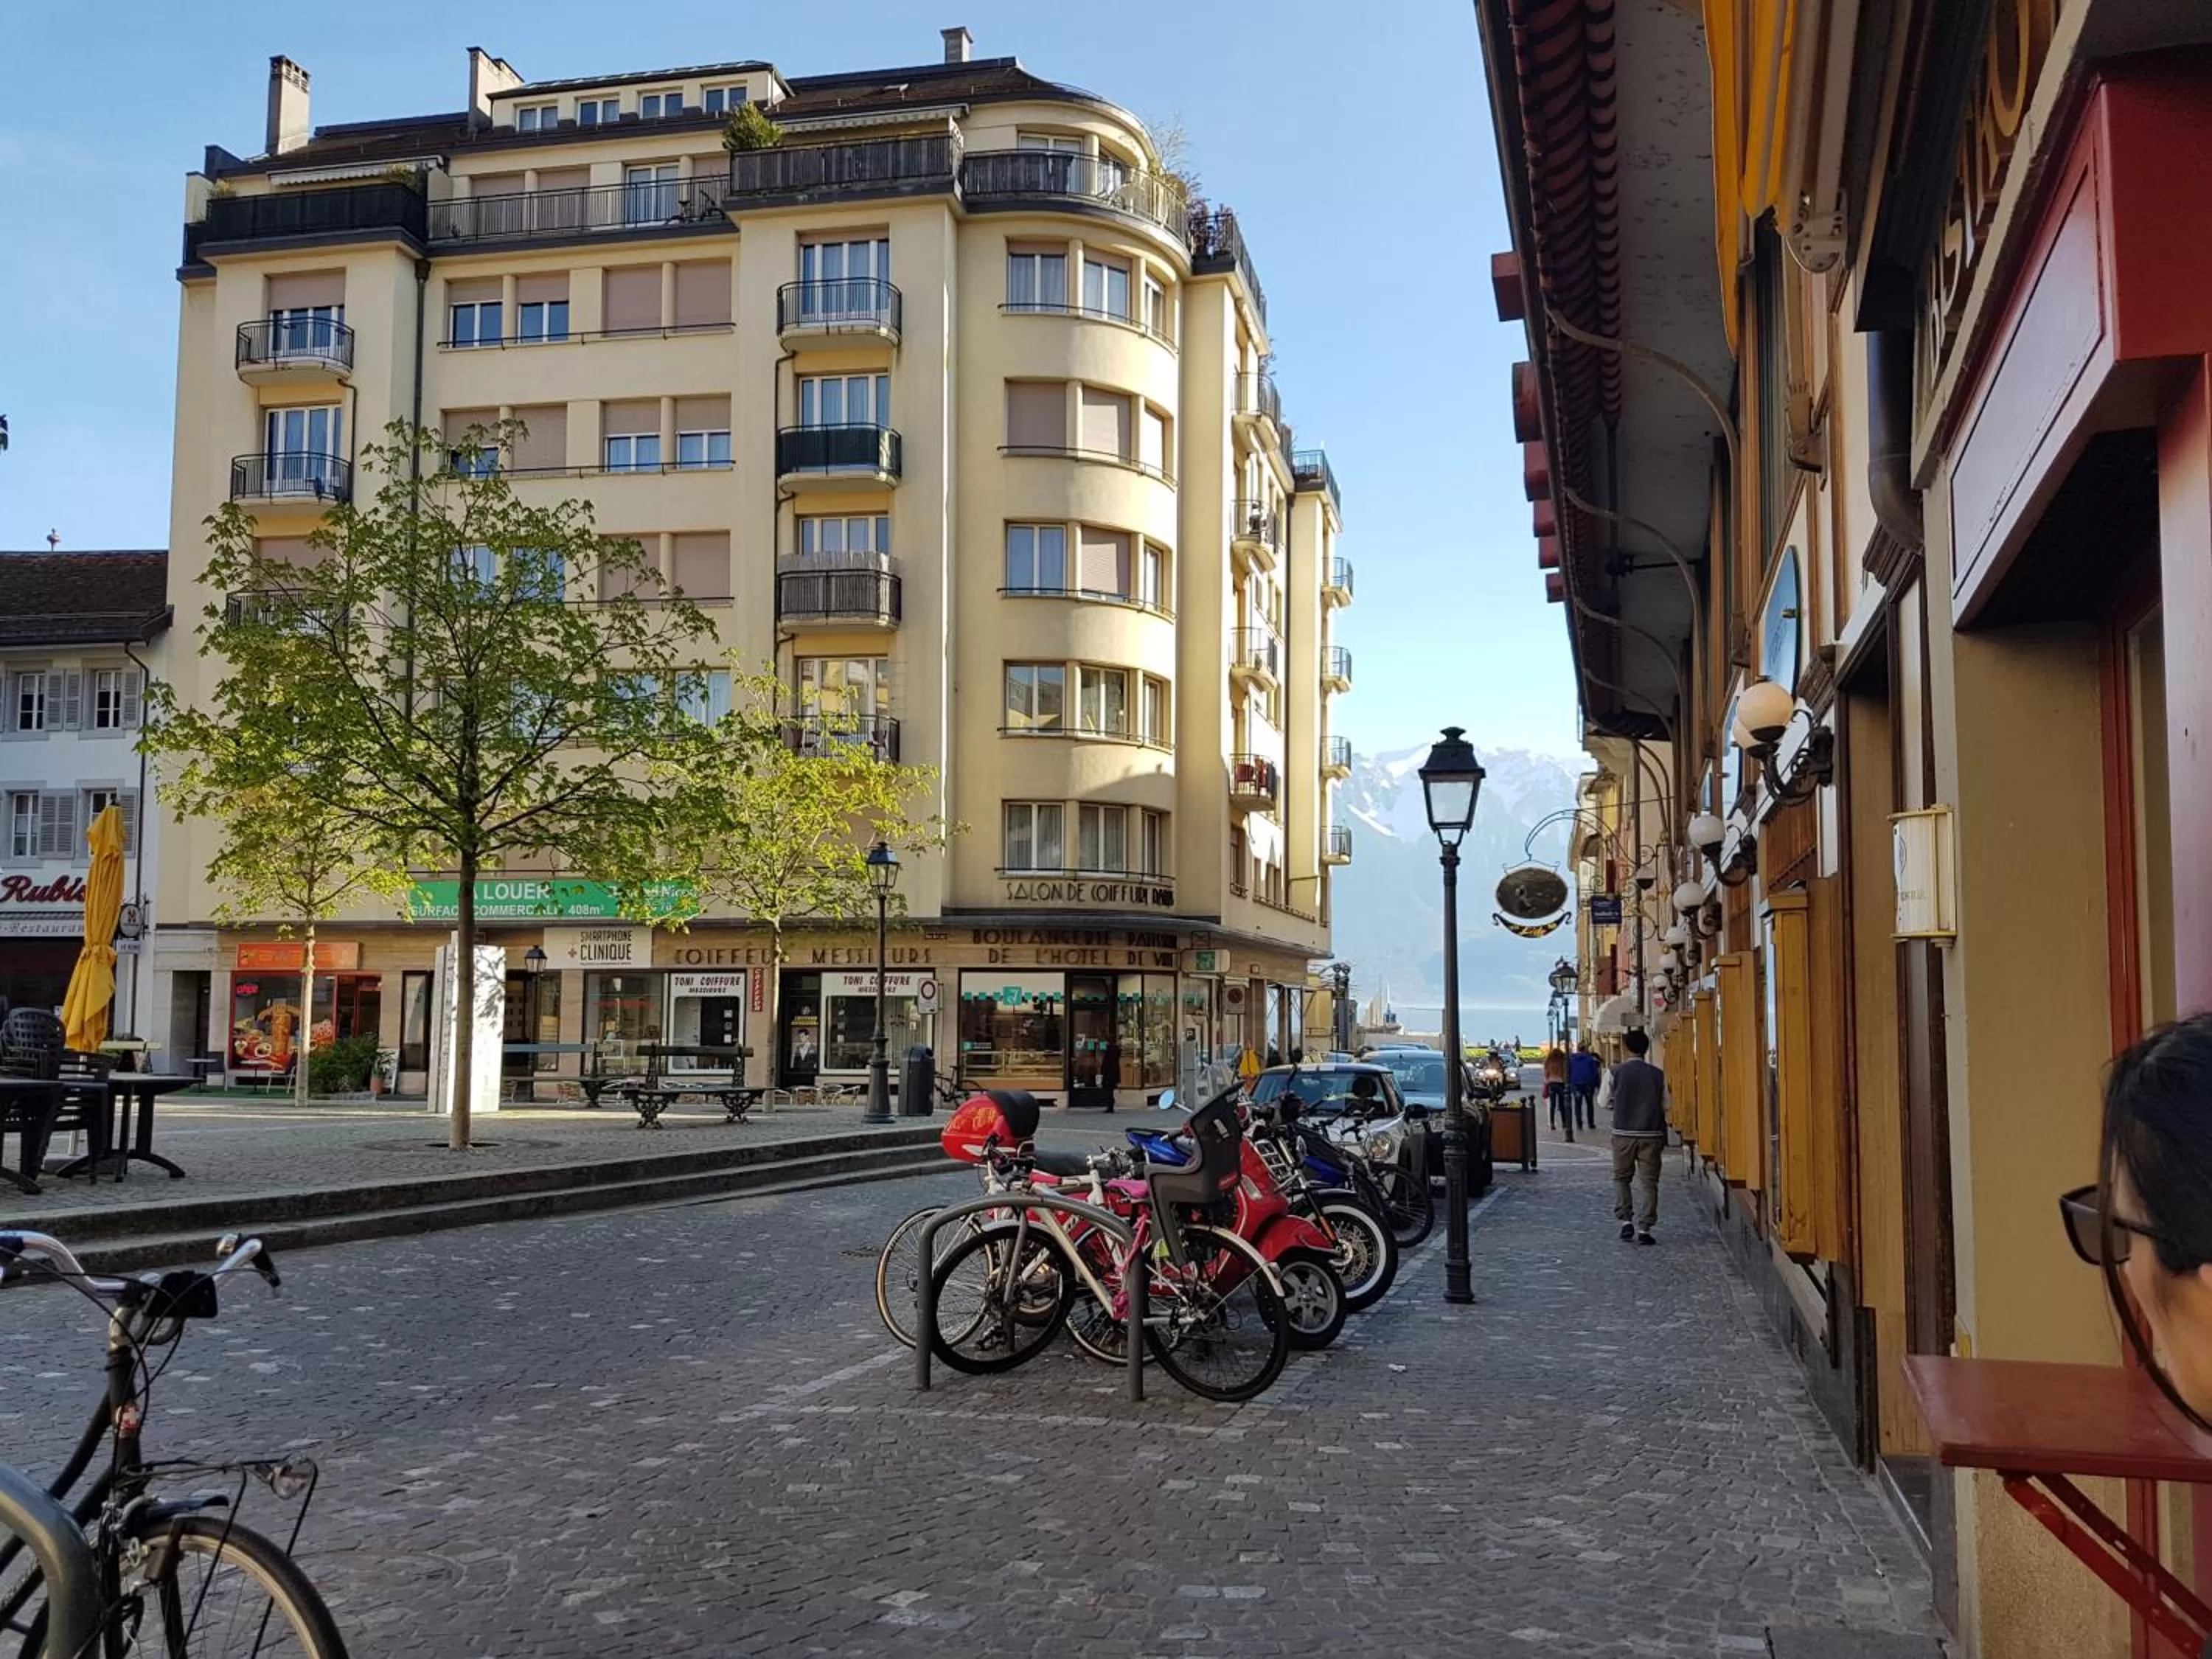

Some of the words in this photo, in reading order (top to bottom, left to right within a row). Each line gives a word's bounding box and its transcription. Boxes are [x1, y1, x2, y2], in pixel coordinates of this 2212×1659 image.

[484, 883, 552, 900] LOUER
[1006, 882, 1062, 902] SALON
[1068, 883, 1085, 902] DE
[411, 905, 460, 917] SURFAC
[580, 930, 632, 942] SMARTPHONE
[580, 943, 632, 961] CLINIQUE
[674, 949, 772, 964] COIFFEU
[812, 947, 931, 964] MESSIURS
[989, 947, 1011, 964] DE
[675, 976, 694, 986] TONI
[700, 976, 741, 986] COIFFURE
[844, 975, 863, 986] TONI
[869, 975, 911, 986] COFFURE
